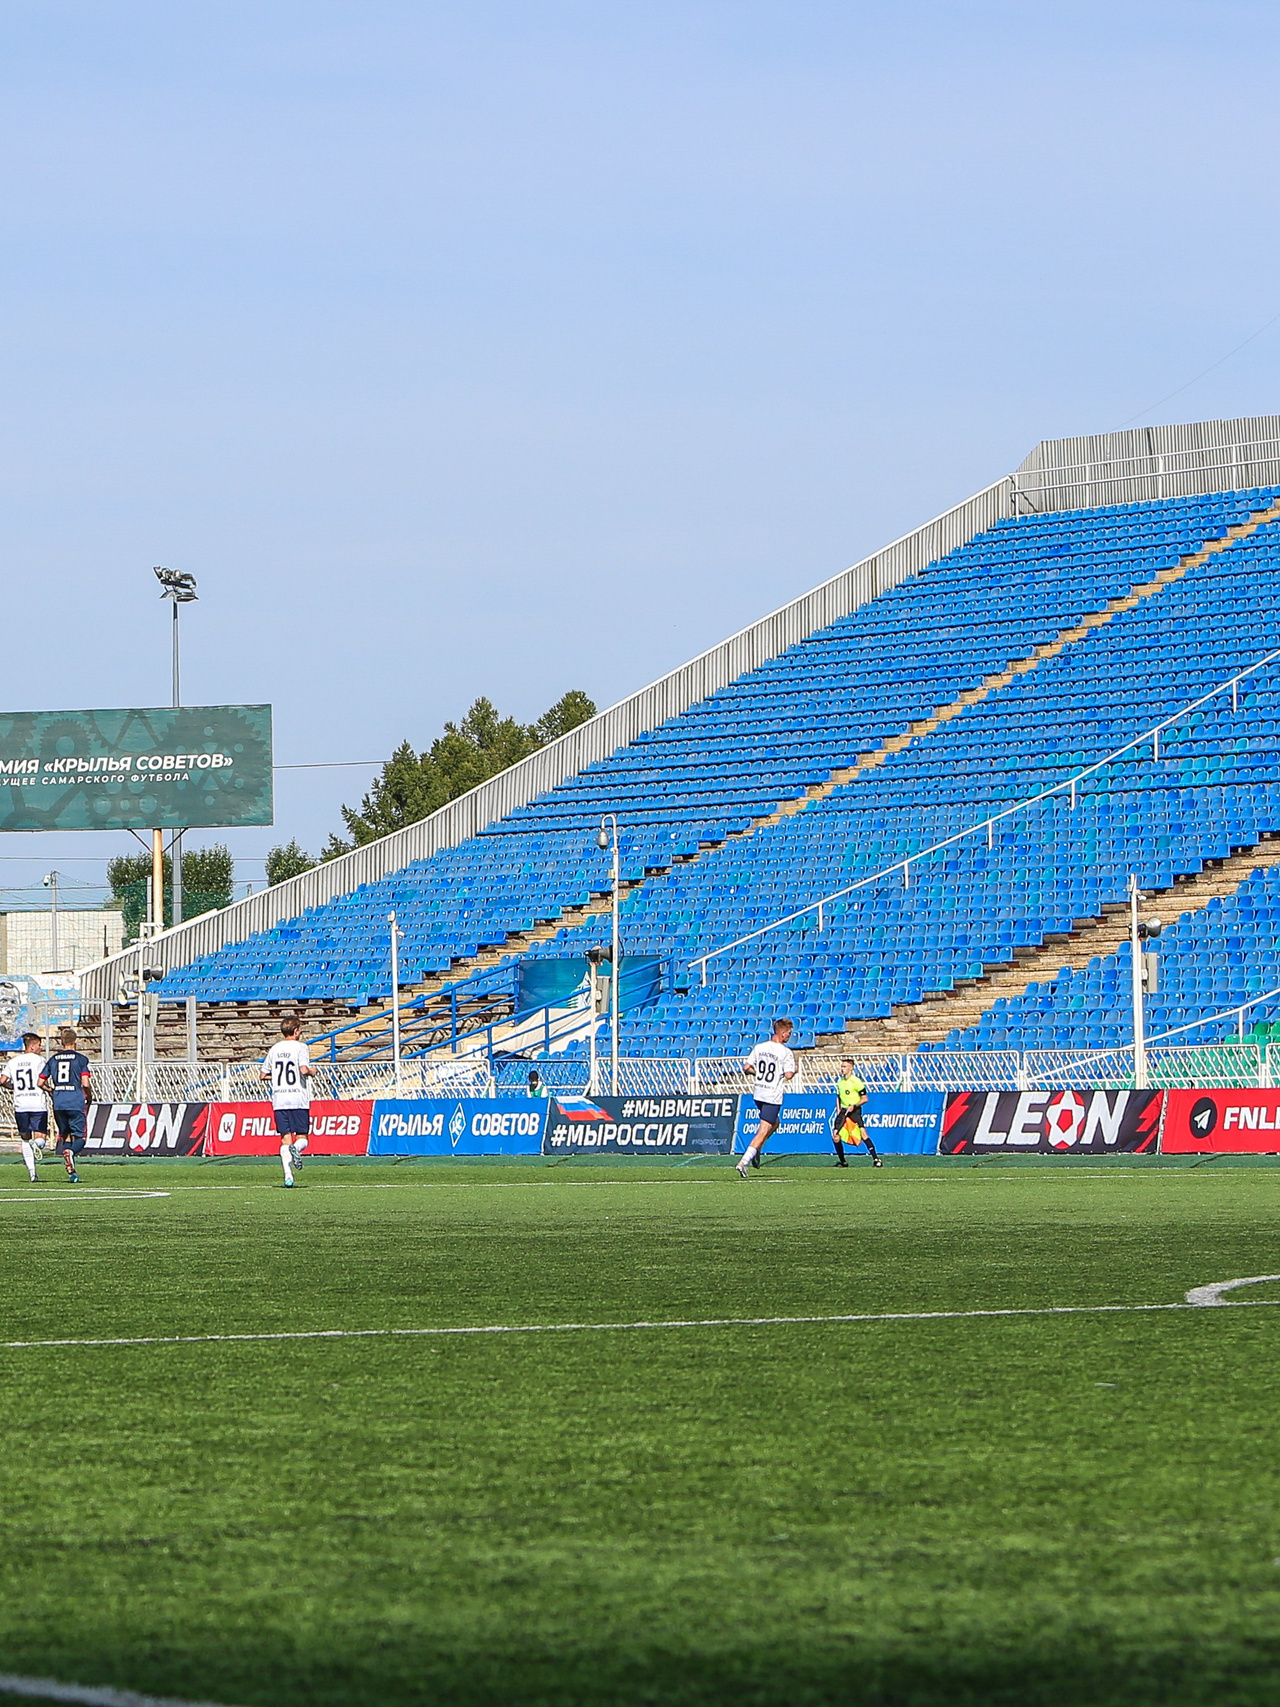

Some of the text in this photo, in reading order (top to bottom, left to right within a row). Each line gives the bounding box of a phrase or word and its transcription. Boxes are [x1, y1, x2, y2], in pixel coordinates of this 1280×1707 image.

[43, 757, 132, 774] «КРЫЛЬЯ
[136, 754, 234, 771] СОВЕТОВ»
[41, 775, 125, 785] САМАРСКОГО
[131, 773, 190, 783] ФУТБОЛА
[16, 1068, 35, 1091] 51
[57, 1061, 71, 1083] 8
[275, 1060, 296, 1086] 76
[757, 1060, 776, 1083] 98
[622, 1098, 734, 1118] #МЫВМЕСТЕ
[782, 1108, 813, 1119] БИЛЕТЫ
[815, 1108, 826, 1119] НА
[1223, 1106, 1280, 1130] FNL
[84, 1103, 187, 1152] LEON
[377, 1112, 540, 1137] КРЫЛЬЯ СОВЕТОВ
[800, 1120, 824, 1135] САЙТЕ
[973, 1091, 1131, 1149] LEON
[550, 1123, 689, 1148] #МЫРОССИЯ
